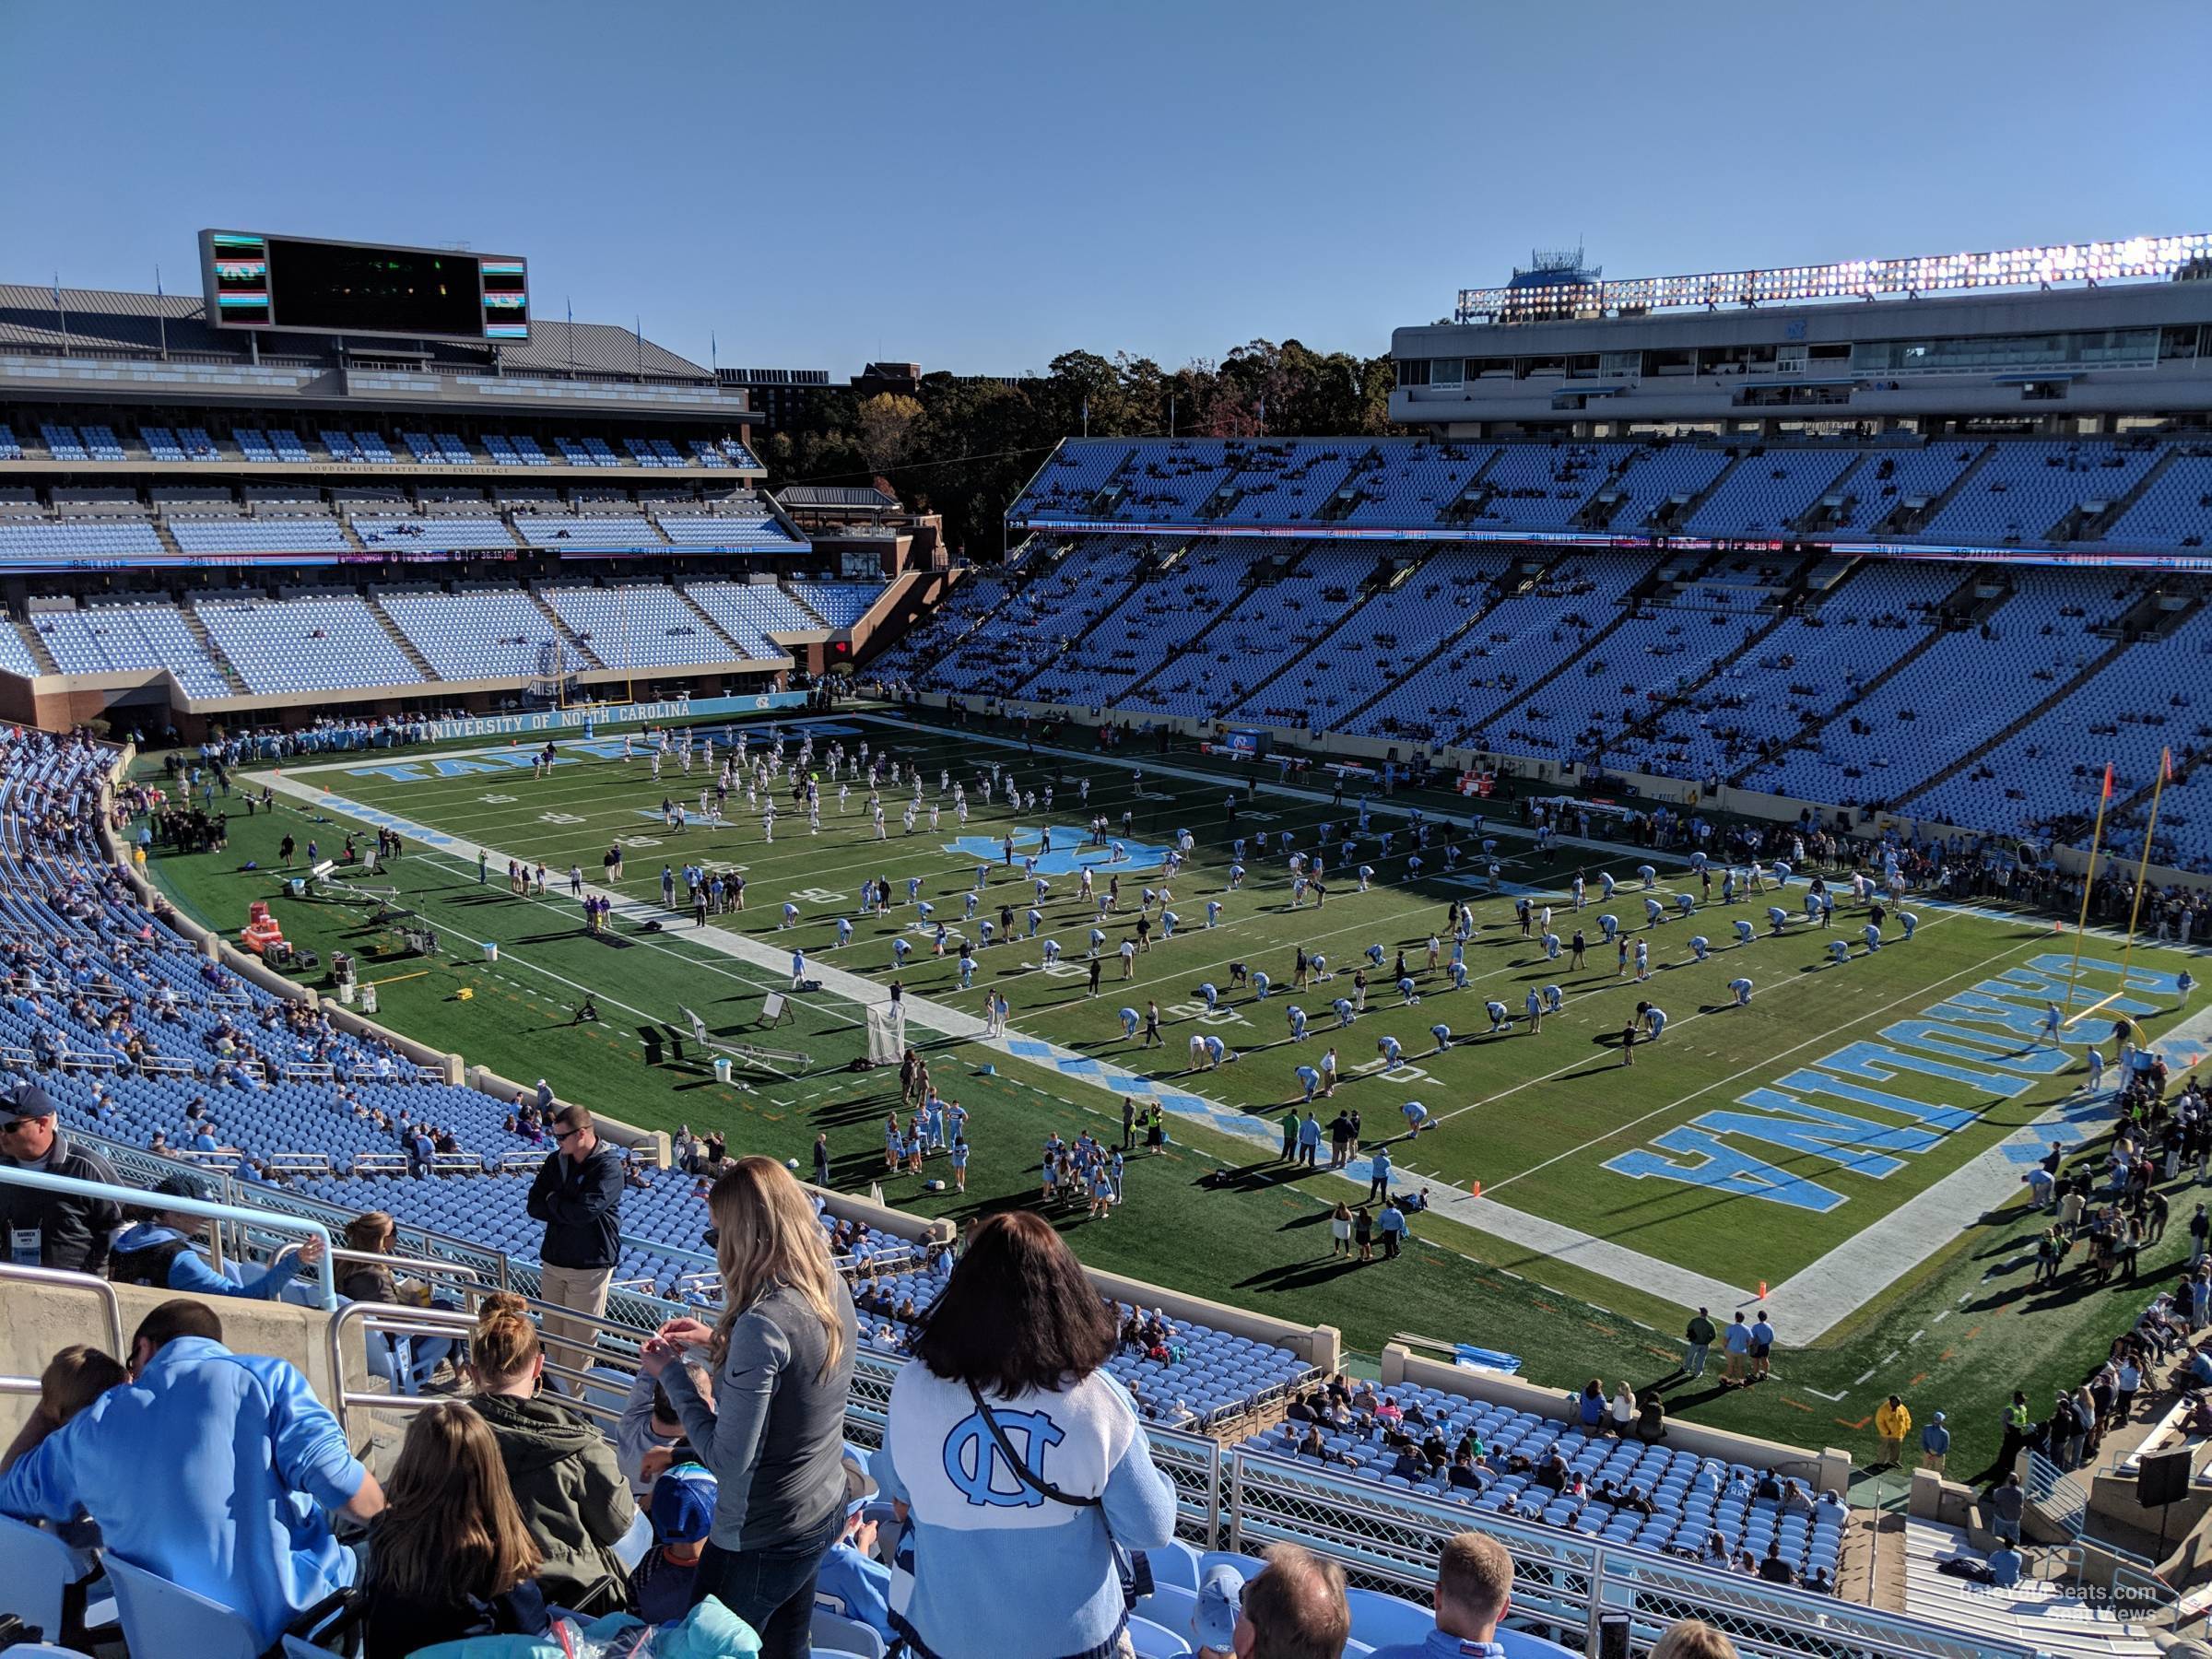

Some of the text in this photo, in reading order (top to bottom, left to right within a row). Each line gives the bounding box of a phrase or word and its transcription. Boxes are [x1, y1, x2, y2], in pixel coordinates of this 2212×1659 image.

[1047, 522, 1079, 531] WELCOME
[1540, 534, 1577, 543] SIMMONS
[1656, 537, 1664, 548] 0
[1717, 539, 1724, 550] 0
[391, 552, 398, 562] 0
[454, 550, 462, 560] 0
[481, 551, 503, 559] 36:15
[531, 714, 550, 730] OF
[561, 712, 610, 727] NOTH
[619, 702, 689, 722] CAROLINA
[344, 751, 582, 782] TAR
[790, 888, 848, 903] 50
[1164, 1001, 1244, 1025] 20
[1600, 954, 2199, 1213] CAROLINA
